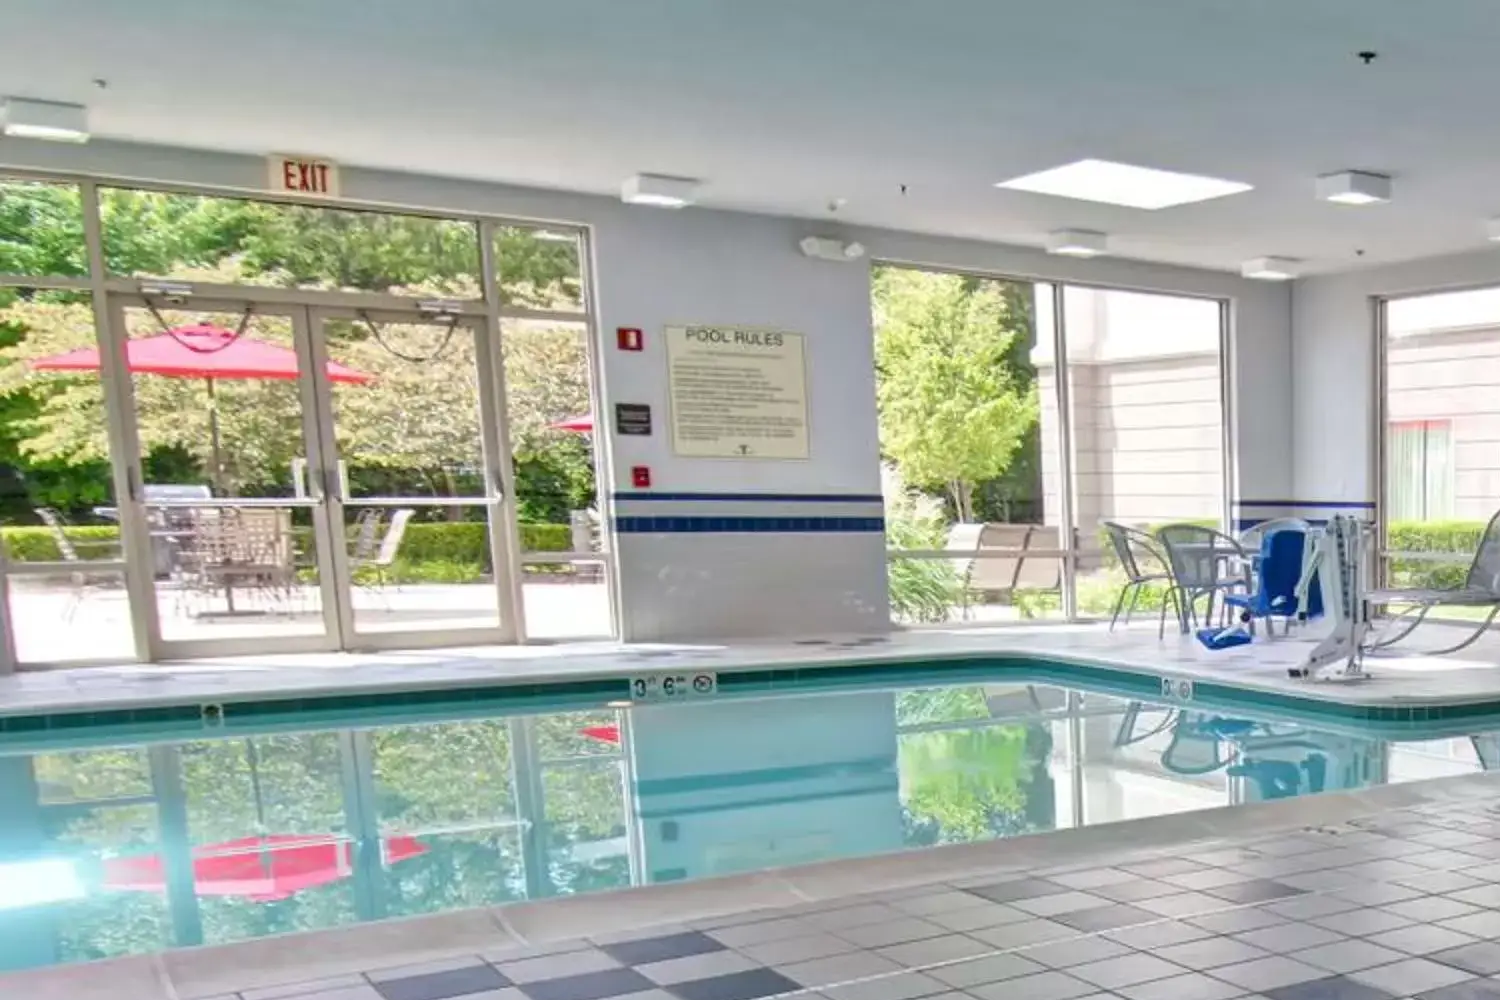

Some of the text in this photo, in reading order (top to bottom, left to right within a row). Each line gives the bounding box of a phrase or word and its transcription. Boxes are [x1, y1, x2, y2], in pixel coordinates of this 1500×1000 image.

[283, 160, 331, 193] EXIT
[685, 327, 785, 346] POOL RULES
